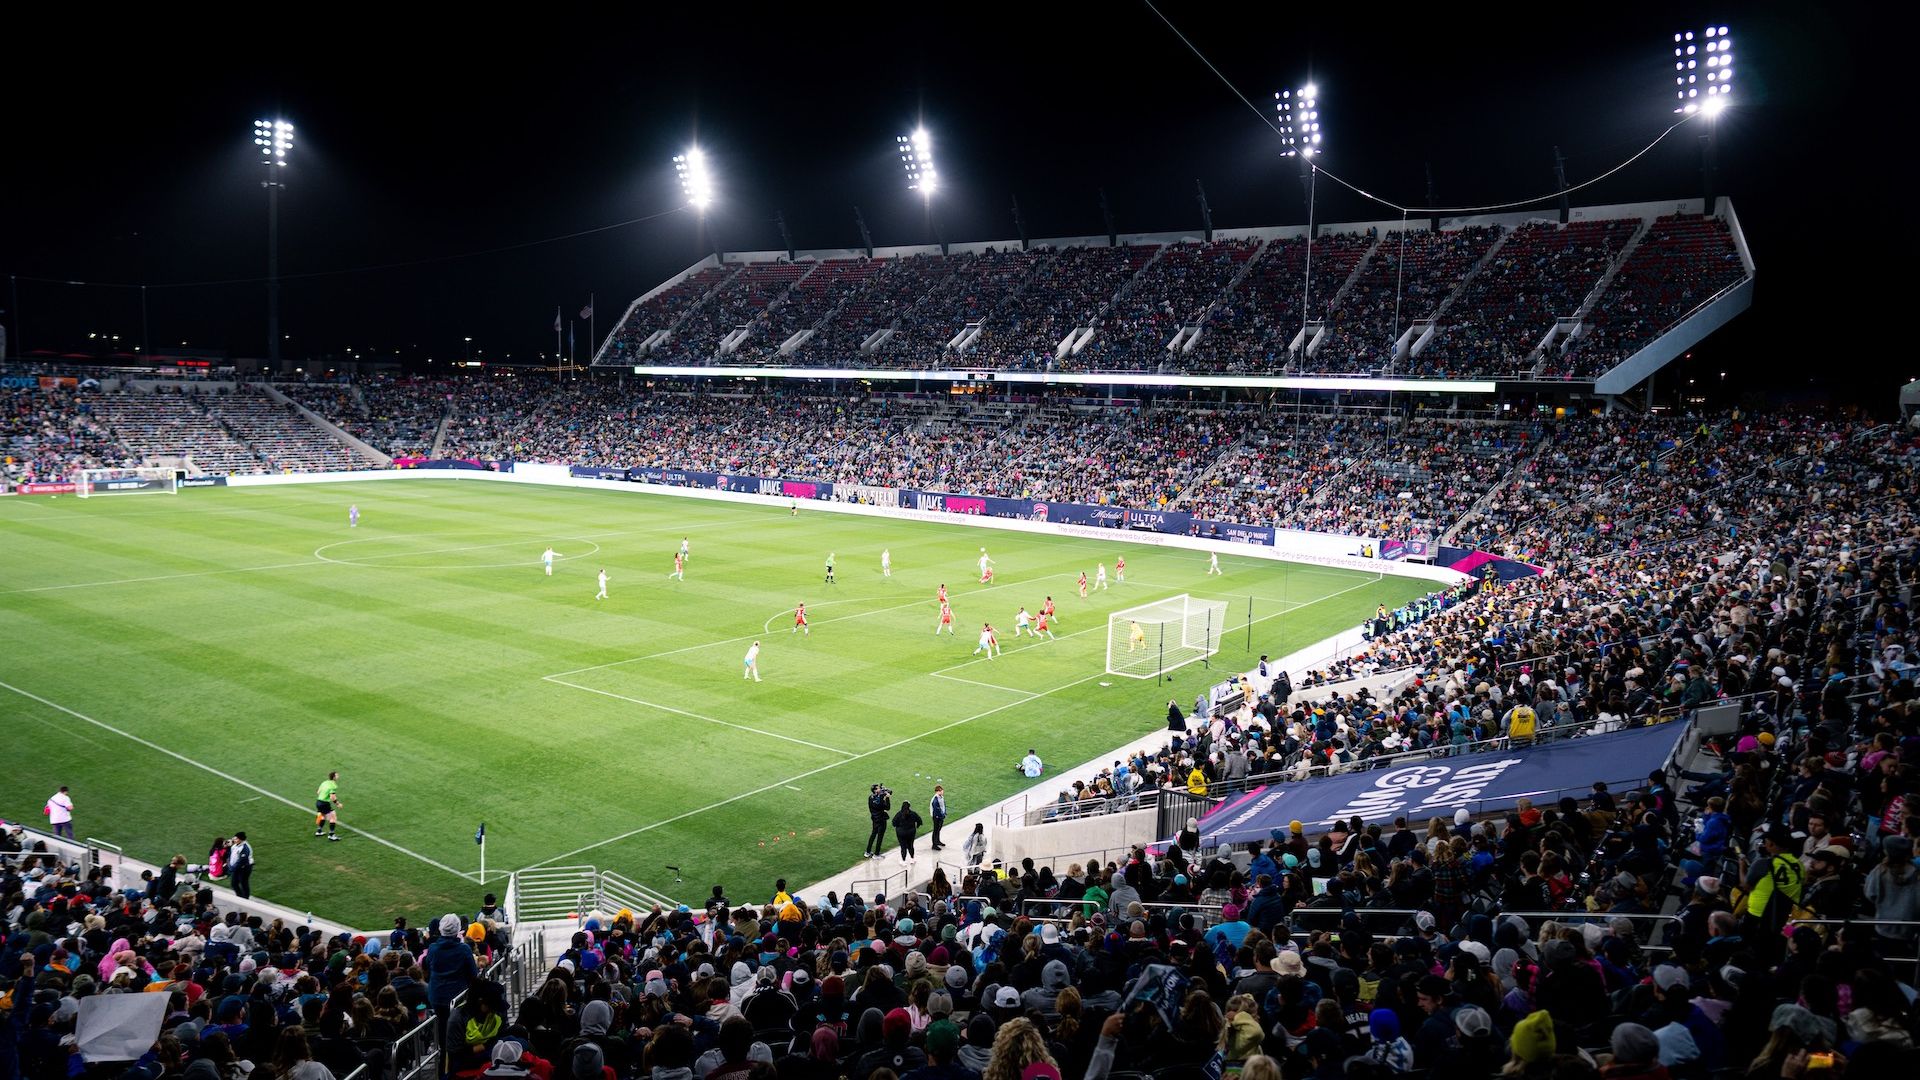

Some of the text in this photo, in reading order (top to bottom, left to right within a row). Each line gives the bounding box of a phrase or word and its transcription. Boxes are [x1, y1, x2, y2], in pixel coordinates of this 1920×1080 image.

[1, 377, 36, 388] COVE
[760, 480, 780, 494] MAKE
[870, 490, 895, 502] FIELD
[917, 494, 942, 510] MAKE
[947, 514, 966, 523] Google
[1131, 513, 1164, 523] ULTRA
[1080, 528, 1099, 537] phone
[1099, 530, 1133, 540] engineered
[1142, 534, 1164, 543] Google
[1253, 532, 1268, 540] WAVE
[1269, 548, 1281, 557] The
[1281, 550, 1296, 560] only
[1296, 552, 1317, 562] phone
[1318, 554, 1357, 566] engineered
[1367, 560, 1395, 571] Google
[1344, 1011, 1370, 1025] HEATH
